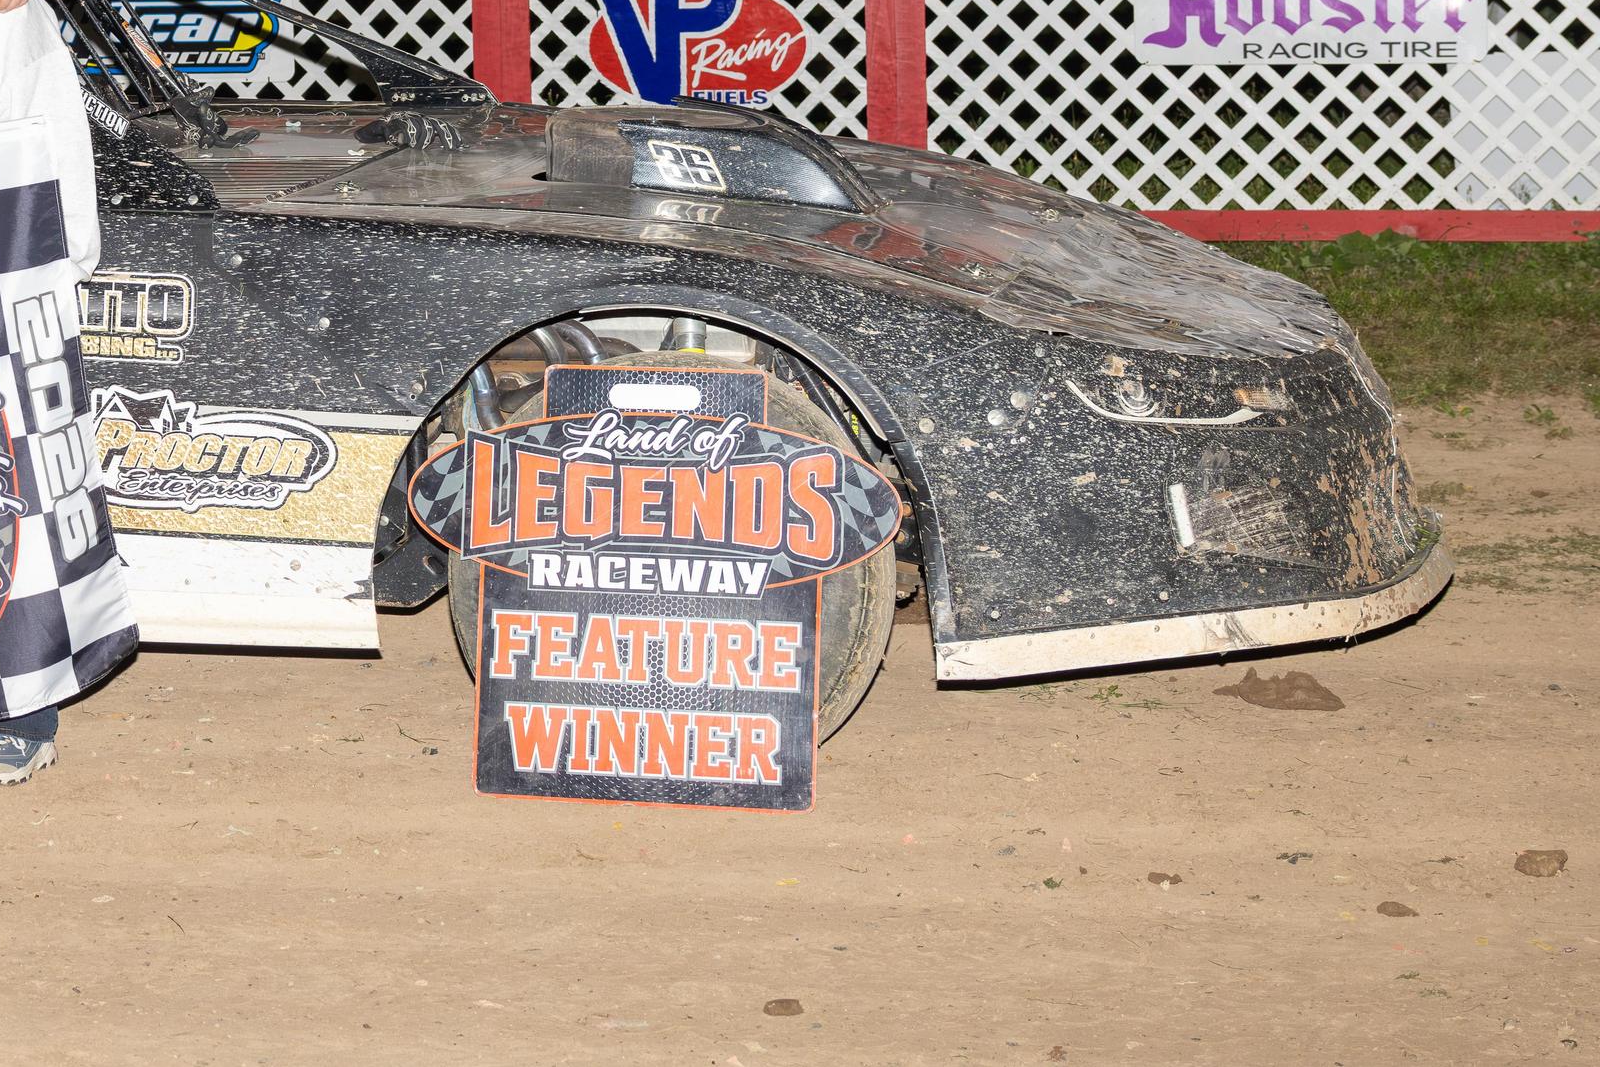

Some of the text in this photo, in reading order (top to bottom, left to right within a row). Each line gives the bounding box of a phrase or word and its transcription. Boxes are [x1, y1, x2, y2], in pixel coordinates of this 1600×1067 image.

[164, 51, 251, 65] ACING
[691, 29, 805, 88] Racing
[1243, 40, 1458, 60] RACING TIRE
[81, 90, 128, 138] CTION
[80, 336, 156, 358] BING
[14, 291, 98, 563] 2026
[97, 418, 315, 479] PROCTOR
[566, 414, 746, 468] Land of
[117, 471, 281, 509] Enterprises
[469, 438, 838, 562] LEGENDS
[530, 553, 769, 596] RACEWAY
[490, 609, 803, 693] FEATURE
[504, 702, 783, 786] WINNER
